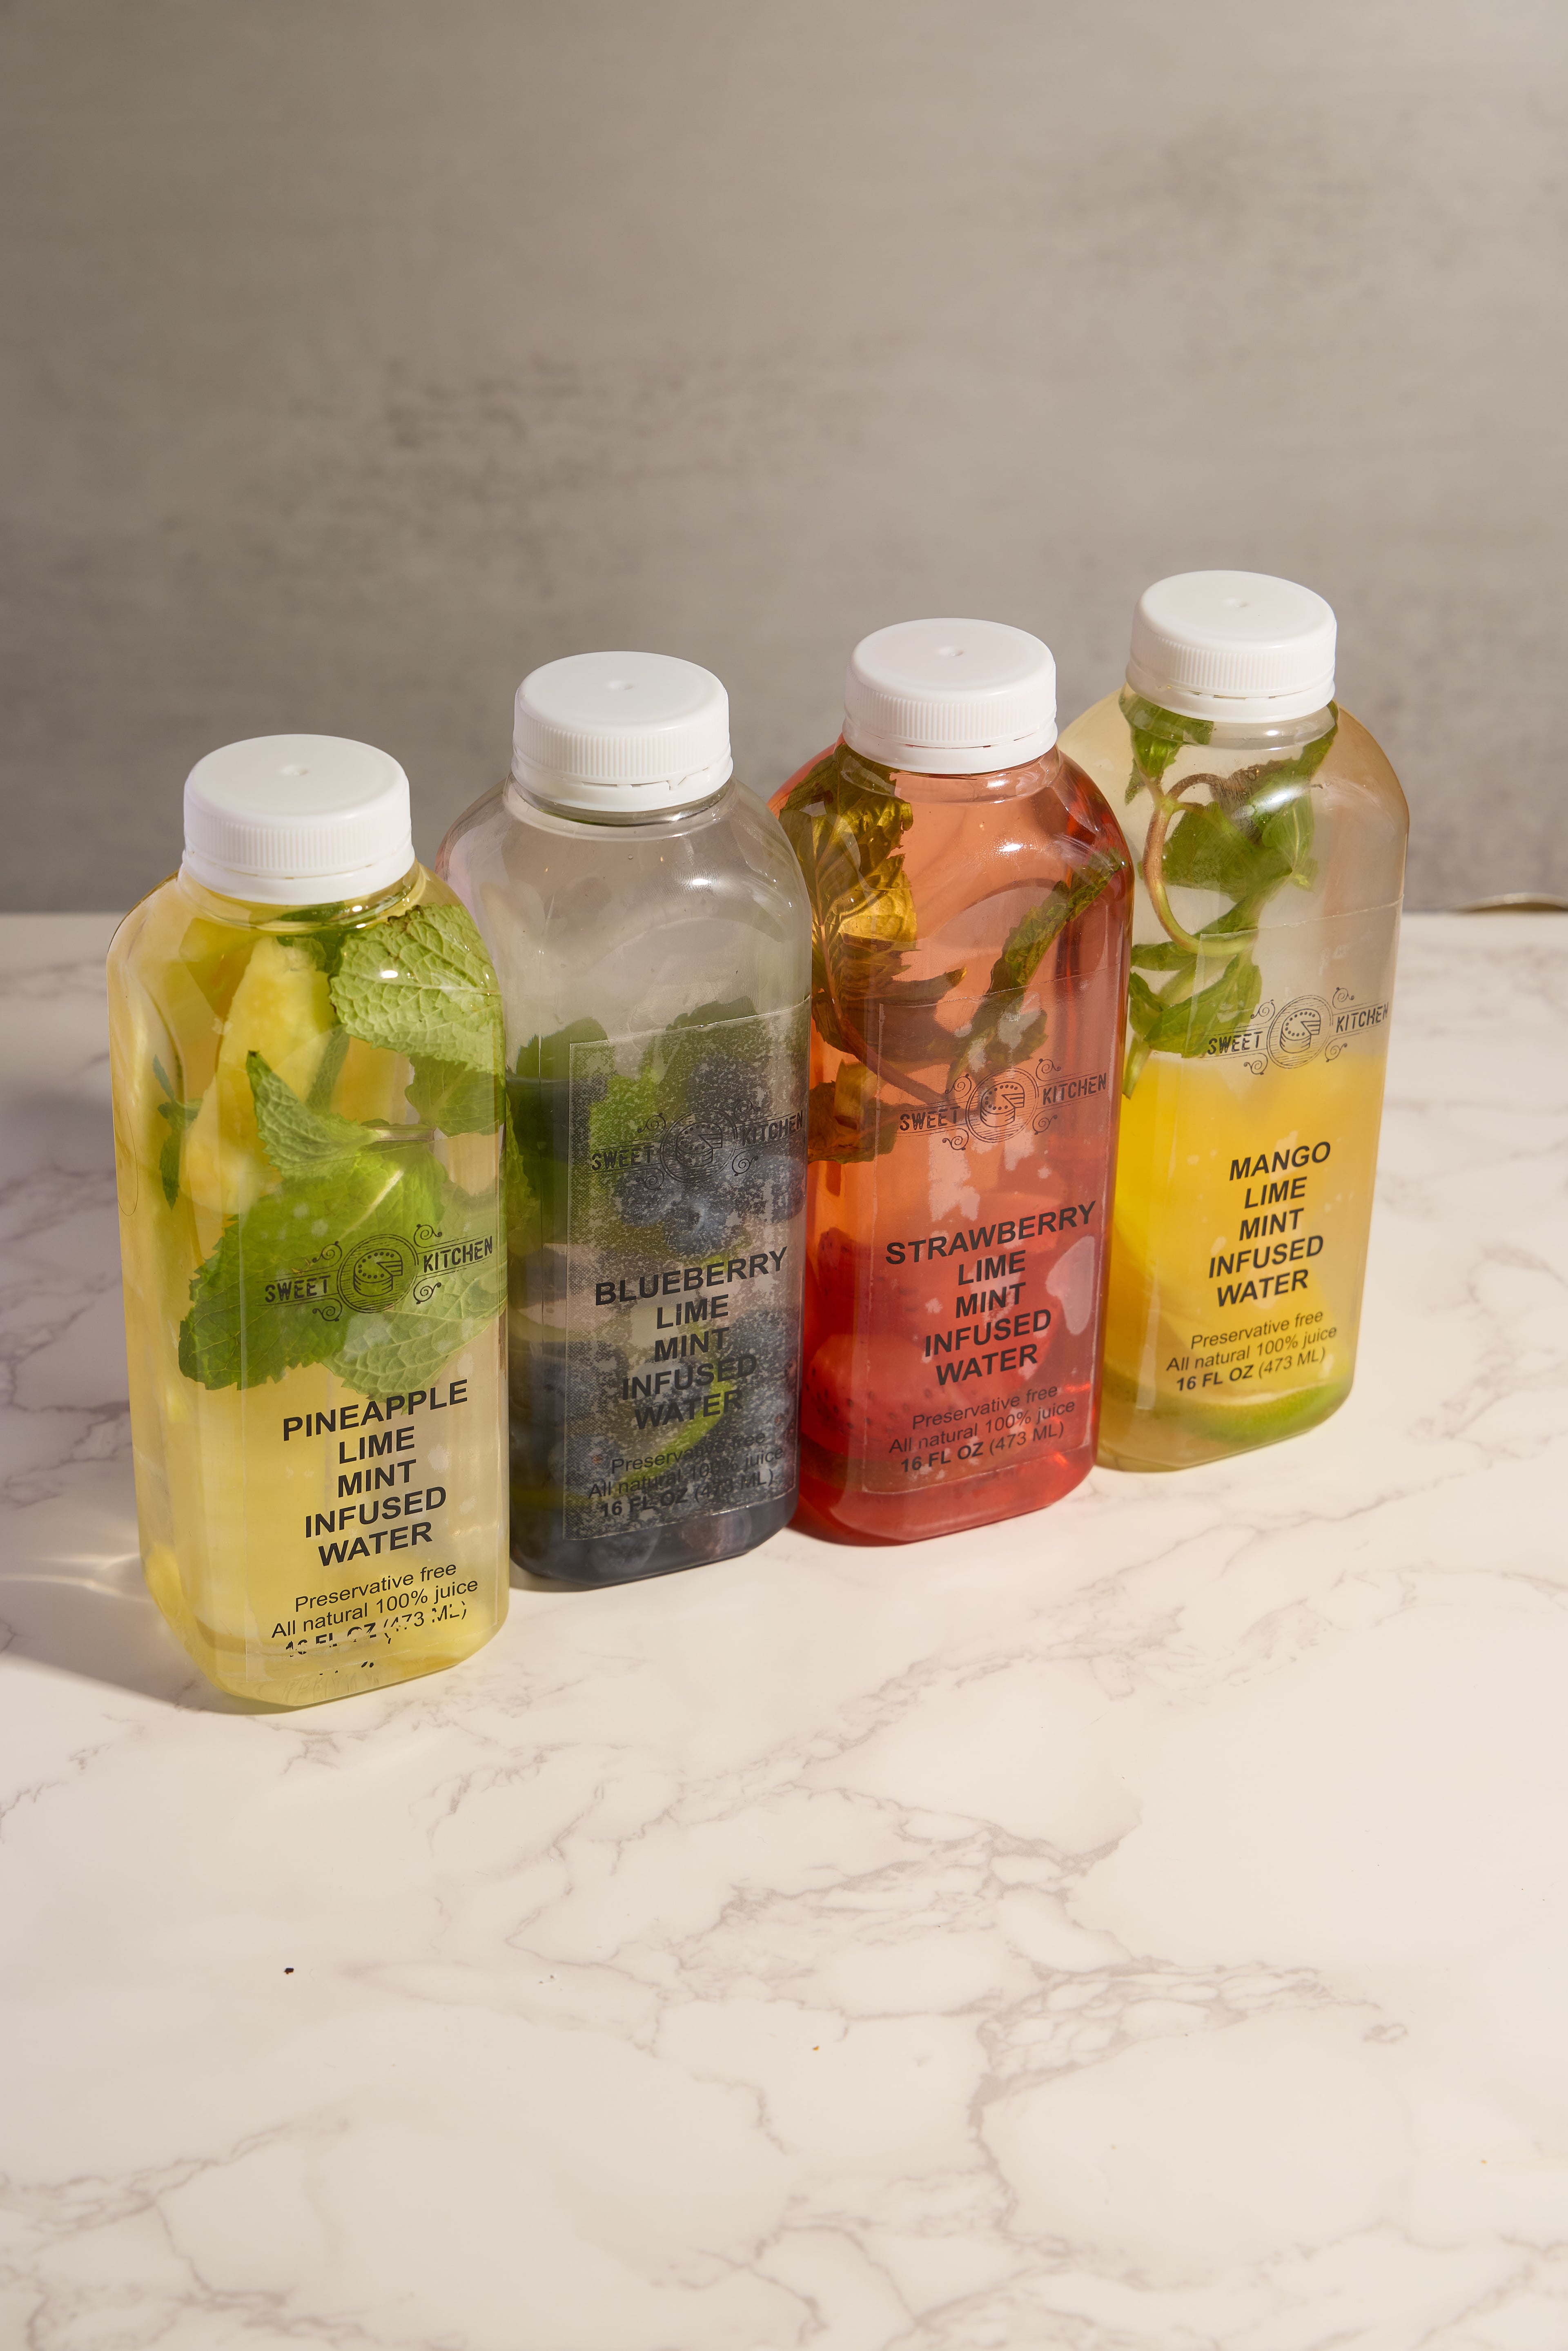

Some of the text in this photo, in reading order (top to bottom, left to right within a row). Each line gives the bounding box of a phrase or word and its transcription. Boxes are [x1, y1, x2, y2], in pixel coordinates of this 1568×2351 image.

[1207, 1001, 1389, 1055] SWEET KITCHEN
[900, 1072, 1107, 1132] SWEET KITCHEN
[591, 1110, 803, 1171] SWEET KITCHEN
[1229, 1141, 1330, 1181] MANGO
[1244, 1176, 1307, 1209] LIME
[885, 1201, 1096, 1265] STRAWBERRY
[1239, 1208, 1304, 1241] MINT
[265, 1236, 493, 1303] SWEET KITCHEN
[595, 1246, 787, 1306] BLUEBERRY
[958, 1250, 1026, 1286] LIME
[1208, 1235, 1323, 1278] INFUSED
[956, 1282, 1026, 1318] MINT
[1217, 1269, 1308, 1307] WATER
[657, 1294, 729, 1329] LIME
[925, 1308, 1051, 1357] INFUSED
[1191, 1310, 1323, 1349] Preservative free
[655, 1327, 730, 1362] MINT
[935, 1344, 1038, 1386] WATER
[1166, 1326, 1337, 1371] All natural 100% juice
[622, 1354, 757, 1400] INFUSED
[1176, 1347, 1326, 1391] 16 FL OZ (473 ML)
[283, 1379, 468, 1441] PINEAPPLE
[635, 1389, 743, 1430] WATER
[889, 1401, 1075, 1453] All natural 100% juice
[912, 1386, 1058, 1430] Preservative free
[339, 1426, 415, 1464] LIME
[901, 1421, 1064, 1472] 16 FL OZ (473 ML)
[338, 1459, 416, 1498] MINT
[588, 1481, 612, 1499] All
[618, 1468, 681, 1494] natural
[744, 1448, 783, 1470] juice
[305, 1486, 446, 1538] INFUSED
[600, 1500, 623, 1517] 16
[318, 1522, 432, 1567] WATER
[271, 1580, 478, 1638] All natural 100% juice
[296, 1564, 457, 1612] Preservative free
